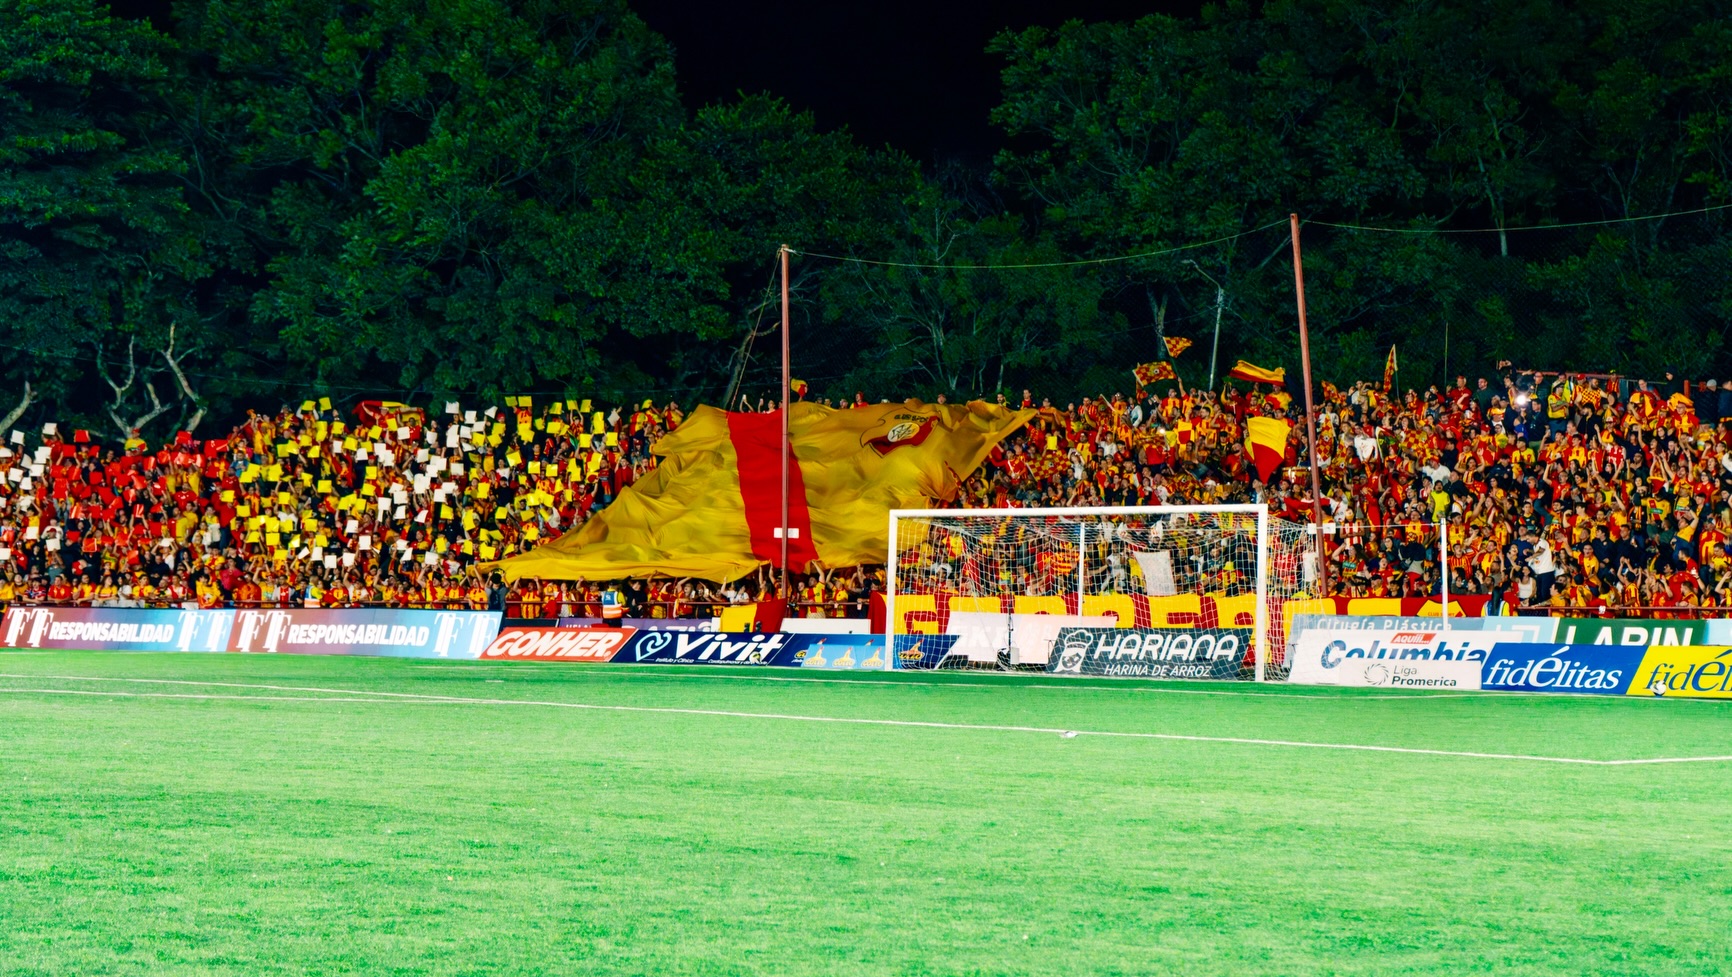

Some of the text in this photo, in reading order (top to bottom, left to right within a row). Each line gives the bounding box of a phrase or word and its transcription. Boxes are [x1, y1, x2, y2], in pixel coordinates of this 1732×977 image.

[49, 622, 174, 643] RESPONSABILIDAD
[287, 624, 430, 647] RESPONSABILIDAD
[486, 631, 623, 657] GONHER
[675, 633, 784, 661] Vivit
[1093, 634, 1239, 661] HARIANA
[1104, 664, 1212, 677] HARINA DE ARROZ
[1393, 665, 1417, 676] Liga
[1483, 646, 1622, 689] fidélitas
[1391, 676, 1457, 687] Promerica
